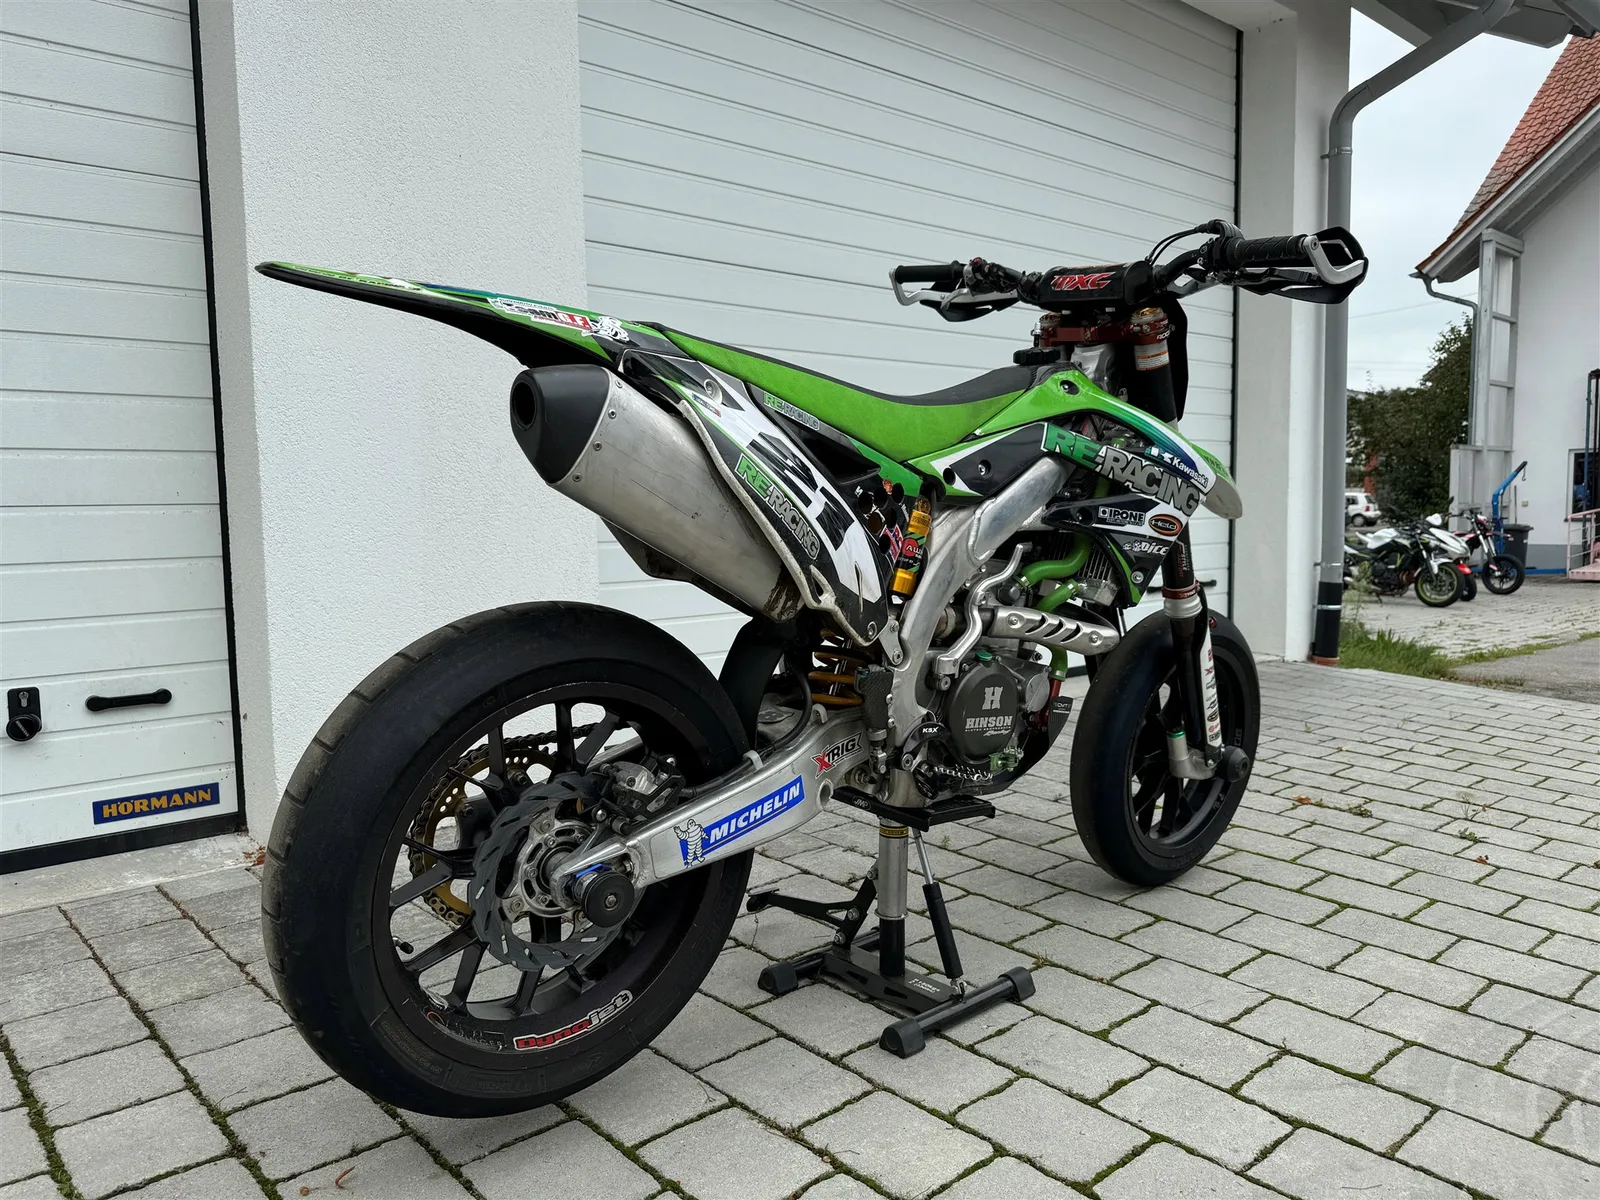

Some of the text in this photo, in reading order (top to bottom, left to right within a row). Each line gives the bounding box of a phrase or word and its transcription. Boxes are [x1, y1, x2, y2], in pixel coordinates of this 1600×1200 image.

[1172, 456, 1209, 489] Kawasaki
[1109, 508, 1145, 521] IPONE
[965, 715, 1014, 729] HINSON
[815, 735, 860, 775] XTRIG
[102, 788, 212, 819] HÖRMANN
[709, 782, 802, 845] MICHELIN
[516, 992, 630, 1050] Dynajet
